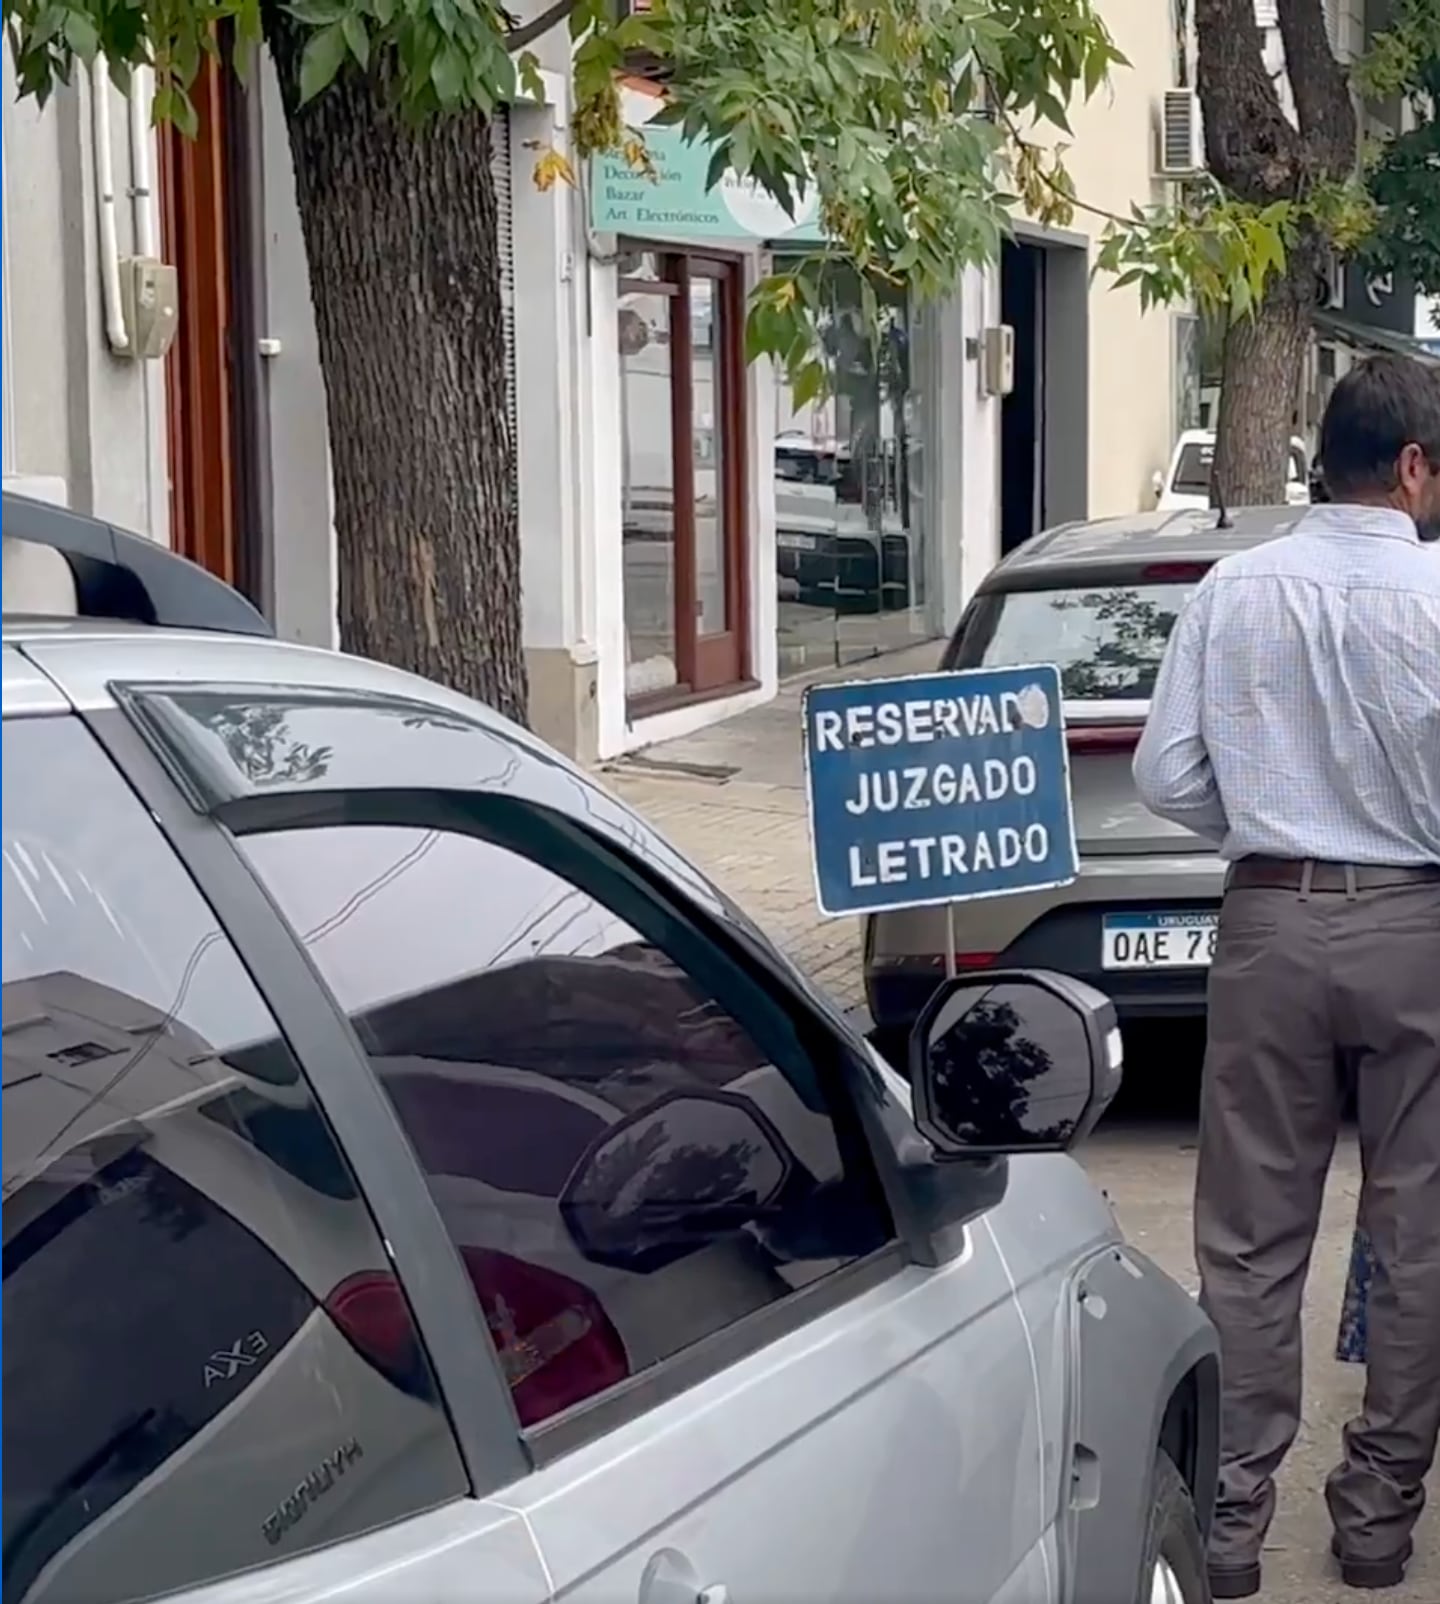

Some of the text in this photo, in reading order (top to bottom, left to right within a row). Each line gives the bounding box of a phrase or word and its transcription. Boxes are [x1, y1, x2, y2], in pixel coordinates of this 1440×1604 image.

[604, 165, 682, 182] Decoión
[606, 186, 645, 201] Bazar
[636, 208, 720, 224] Electrónicos
[845, 756, 1037, 815] JUZGADO
[849, 823, 1049, 887] LETRADO
[1114, 930, 1219, 962] OAE 78
